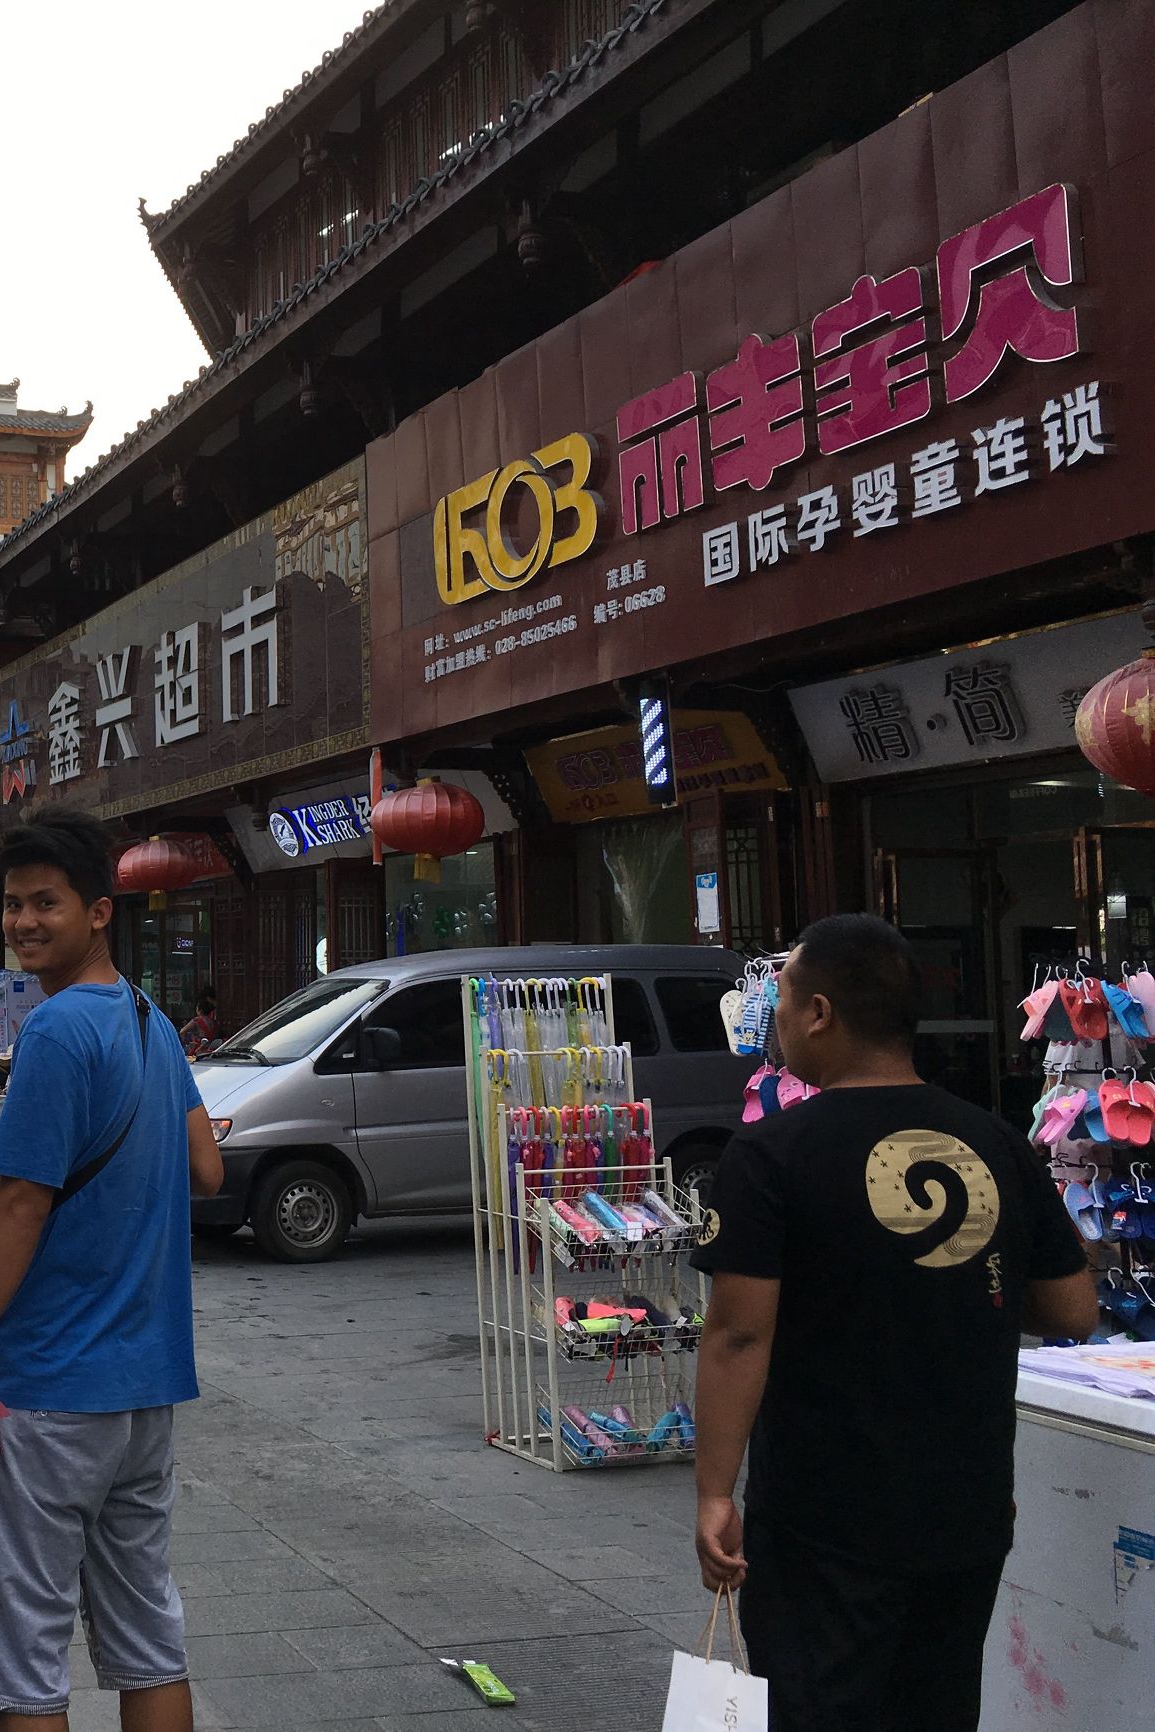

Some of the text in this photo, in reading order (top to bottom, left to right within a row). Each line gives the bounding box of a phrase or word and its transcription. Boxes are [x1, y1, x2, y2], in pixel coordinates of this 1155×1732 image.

[616, 183, 1081, 535] 丽丰宝贝
[702, 381, 1105, 586] 国际孕婴童连锁
[606, 559, 647, 591] 茂县店
[453, 594, 563, 644] www.sc-lifeng.com
[624, 585, 667, 614] 06628
[495, 615, 578, 655] 028-85025466
[48, 584, 278, 786] 鑫兴超市
[317, 819, 360, 845] SHARK
